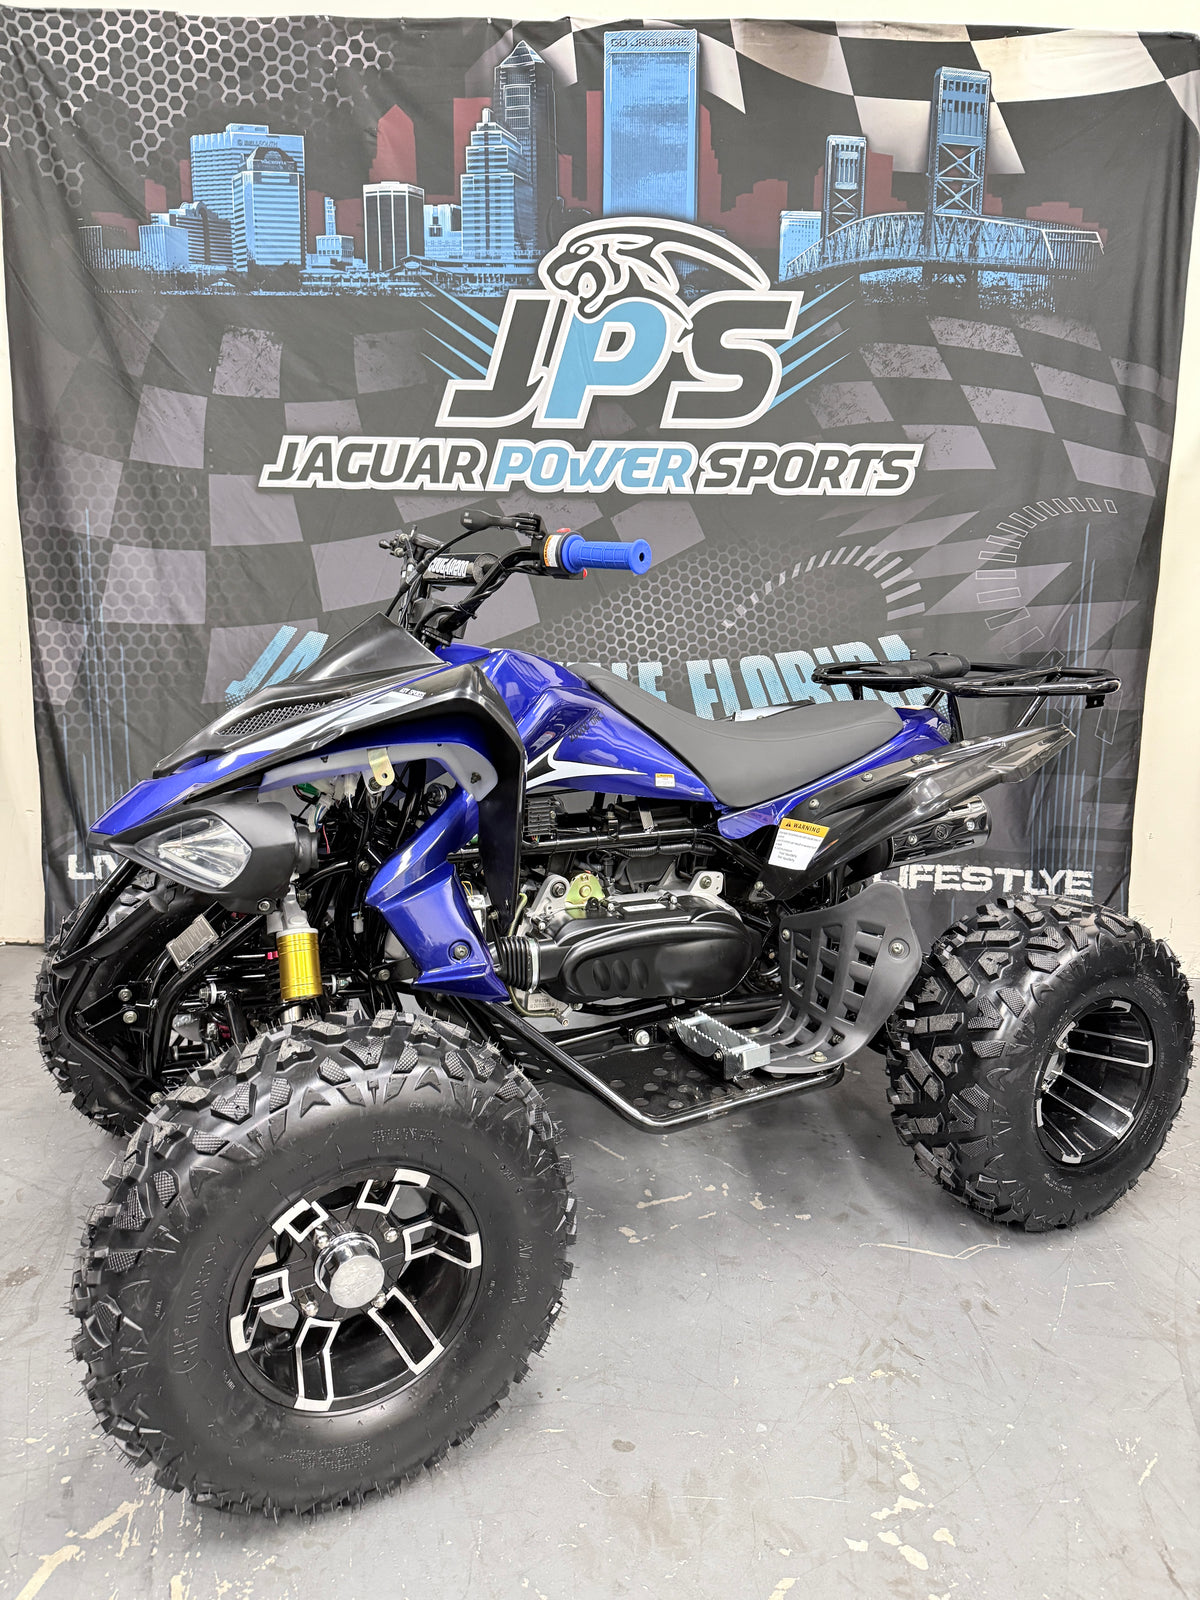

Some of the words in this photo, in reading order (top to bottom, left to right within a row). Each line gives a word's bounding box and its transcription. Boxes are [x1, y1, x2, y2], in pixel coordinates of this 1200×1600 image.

[611, 38, 628, 47] GO
[437, 290, 803, 427] JPS
[261, 437, 483, 490] JAGUAR
[487, 441, 697, 494] POWER
[697, 442, 922, 495] SPORTS
[793, 822, 821, 834] WARNING
